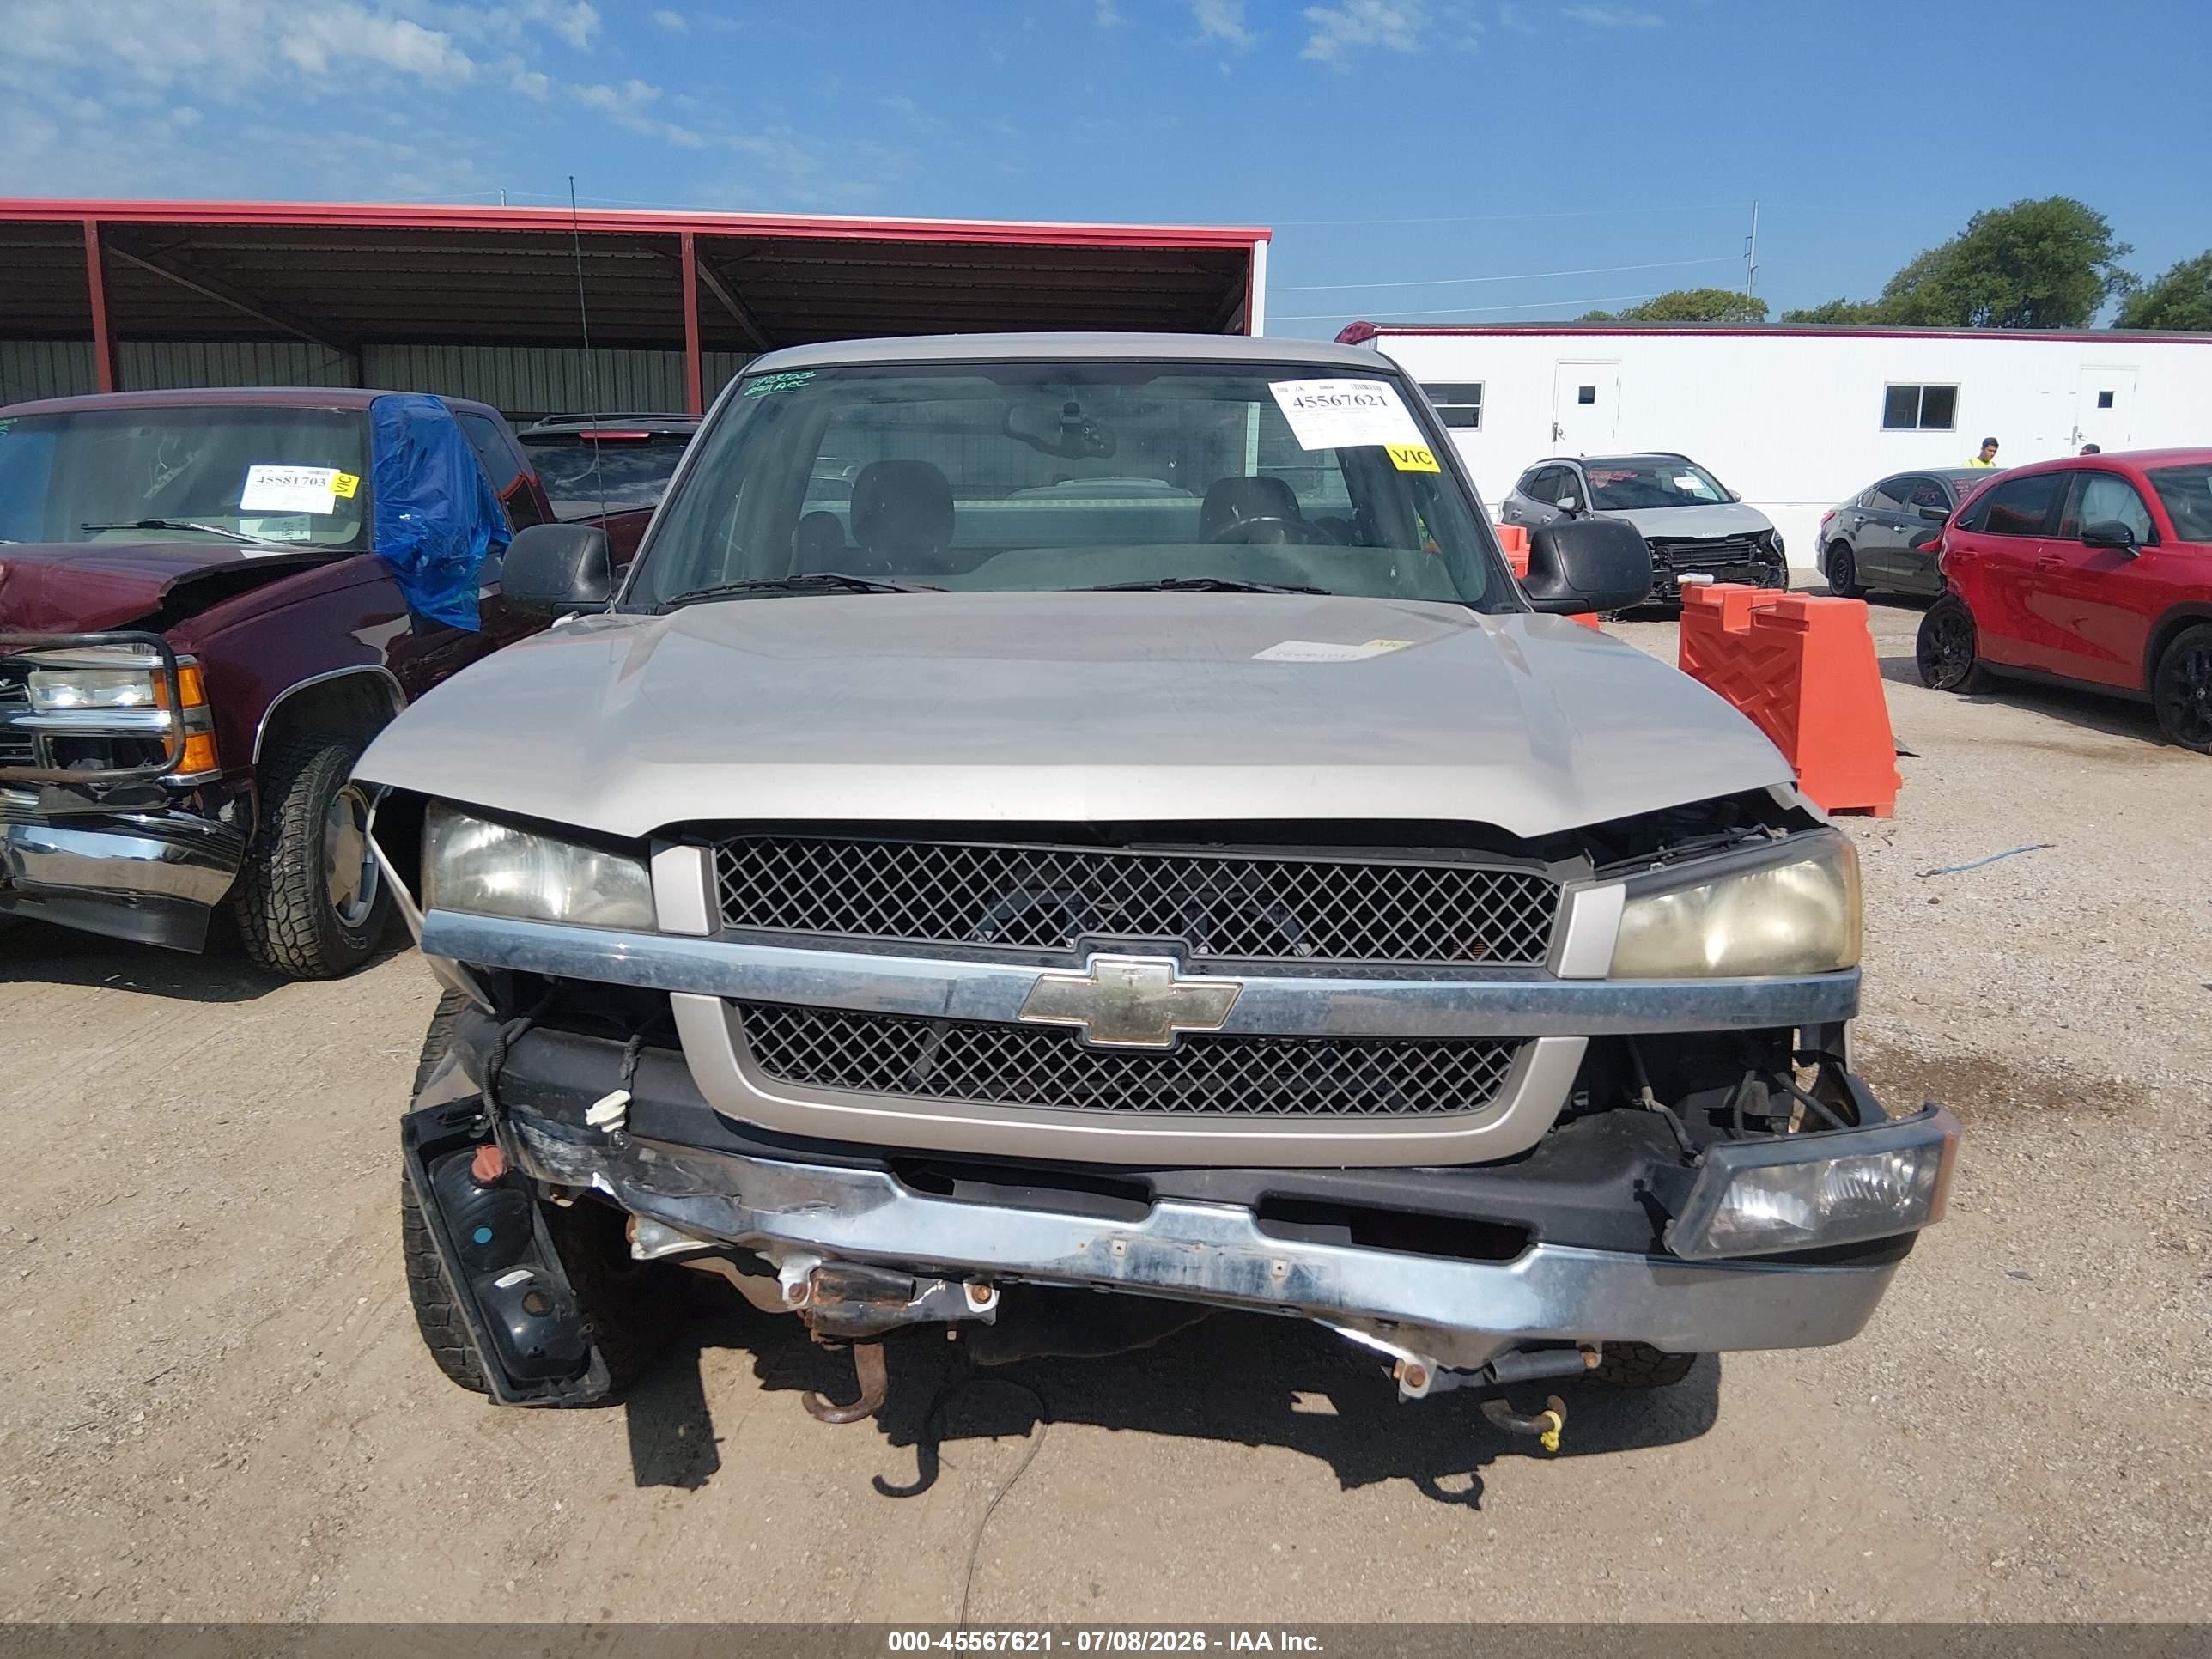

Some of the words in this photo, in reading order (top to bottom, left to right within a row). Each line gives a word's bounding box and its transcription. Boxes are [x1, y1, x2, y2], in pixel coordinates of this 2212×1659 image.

[1293, 394, 1389, 409] 45567621
[1392, 449, 1433, 465] VIC
[256, 476, 326, 487] 45581703
[333, 476, 352, 493] VIC
